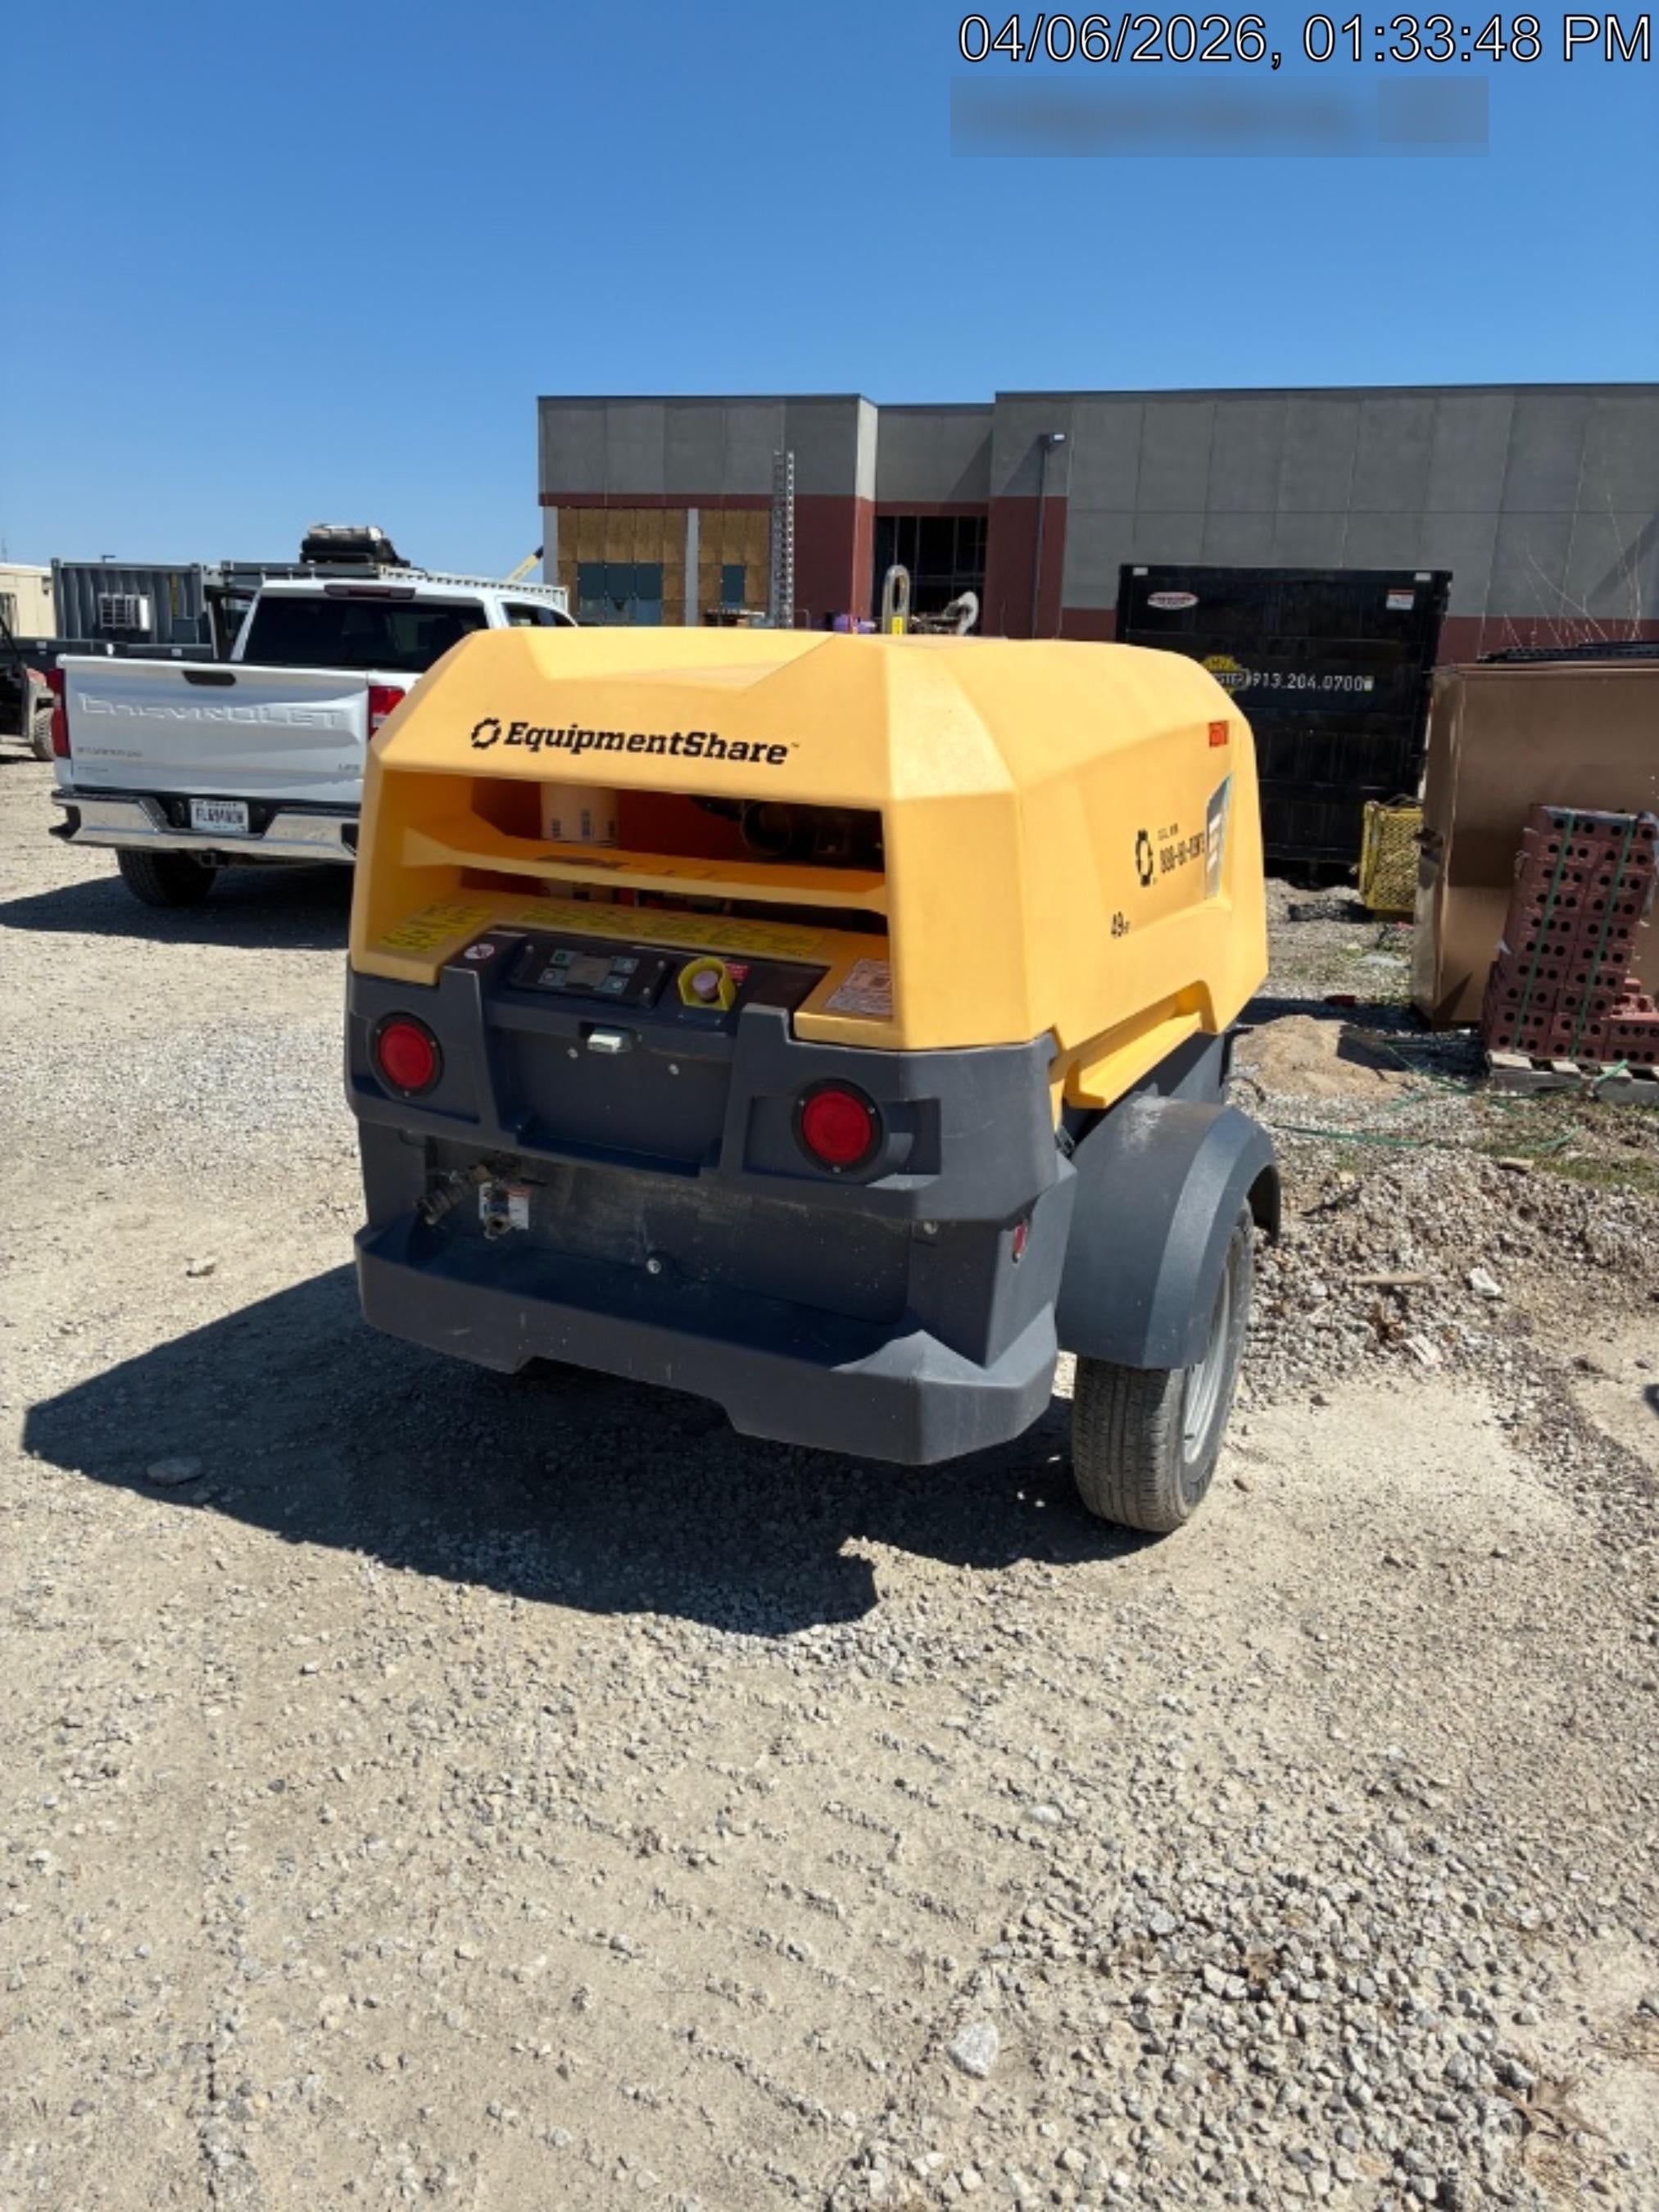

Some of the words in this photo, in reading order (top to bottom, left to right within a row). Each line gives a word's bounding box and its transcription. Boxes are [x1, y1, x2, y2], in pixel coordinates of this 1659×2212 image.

[1252, 672, 1363, 691] 913.204.0700
[78, 692, 344, 728] CHEVROLET
[503, 722, 788, 764] EquipmentShare
